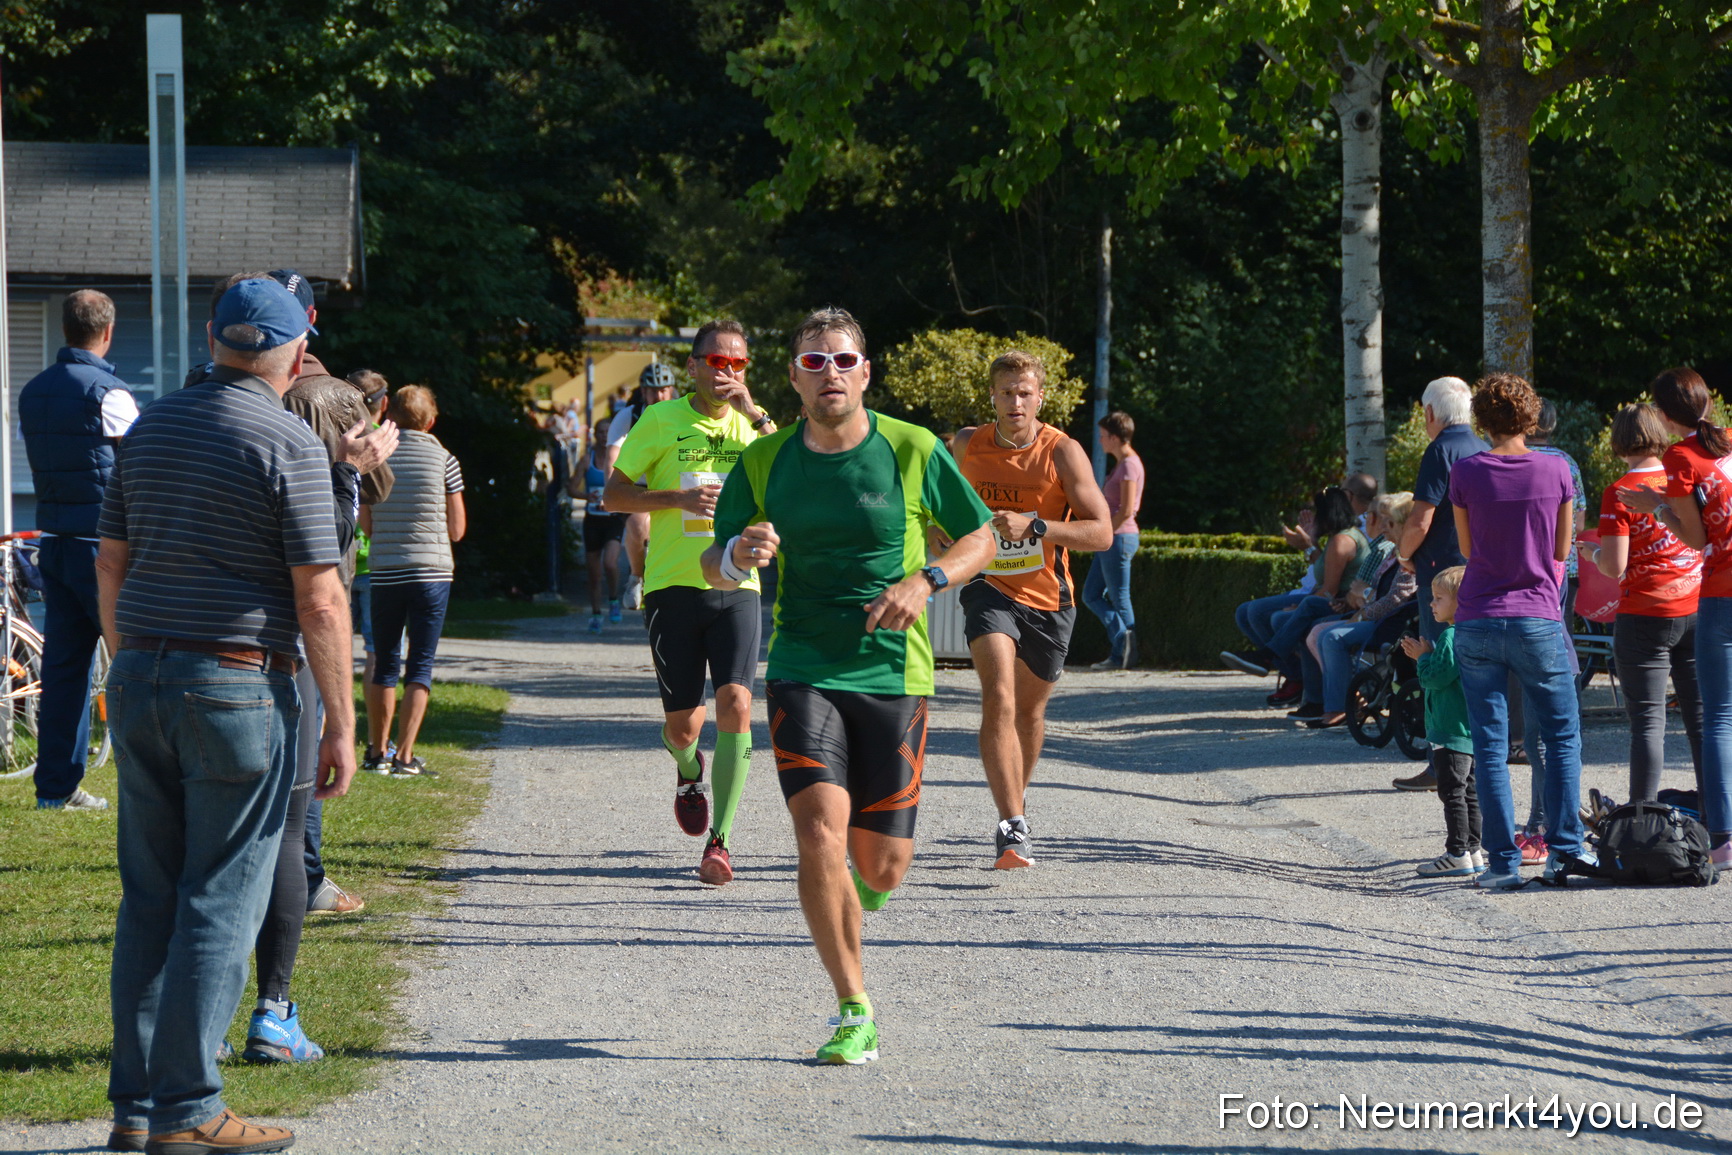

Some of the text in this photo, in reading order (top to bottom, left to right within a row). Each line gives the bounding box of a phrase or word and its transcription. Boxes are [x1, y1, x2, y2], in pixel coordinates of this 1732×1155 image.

[975, 480, 999, 489] OPTIK
[856, 492, 888, 505] AOK
[974, 487, 1024, 503] OEXL
[995, 559, 1025, 569] Richard
